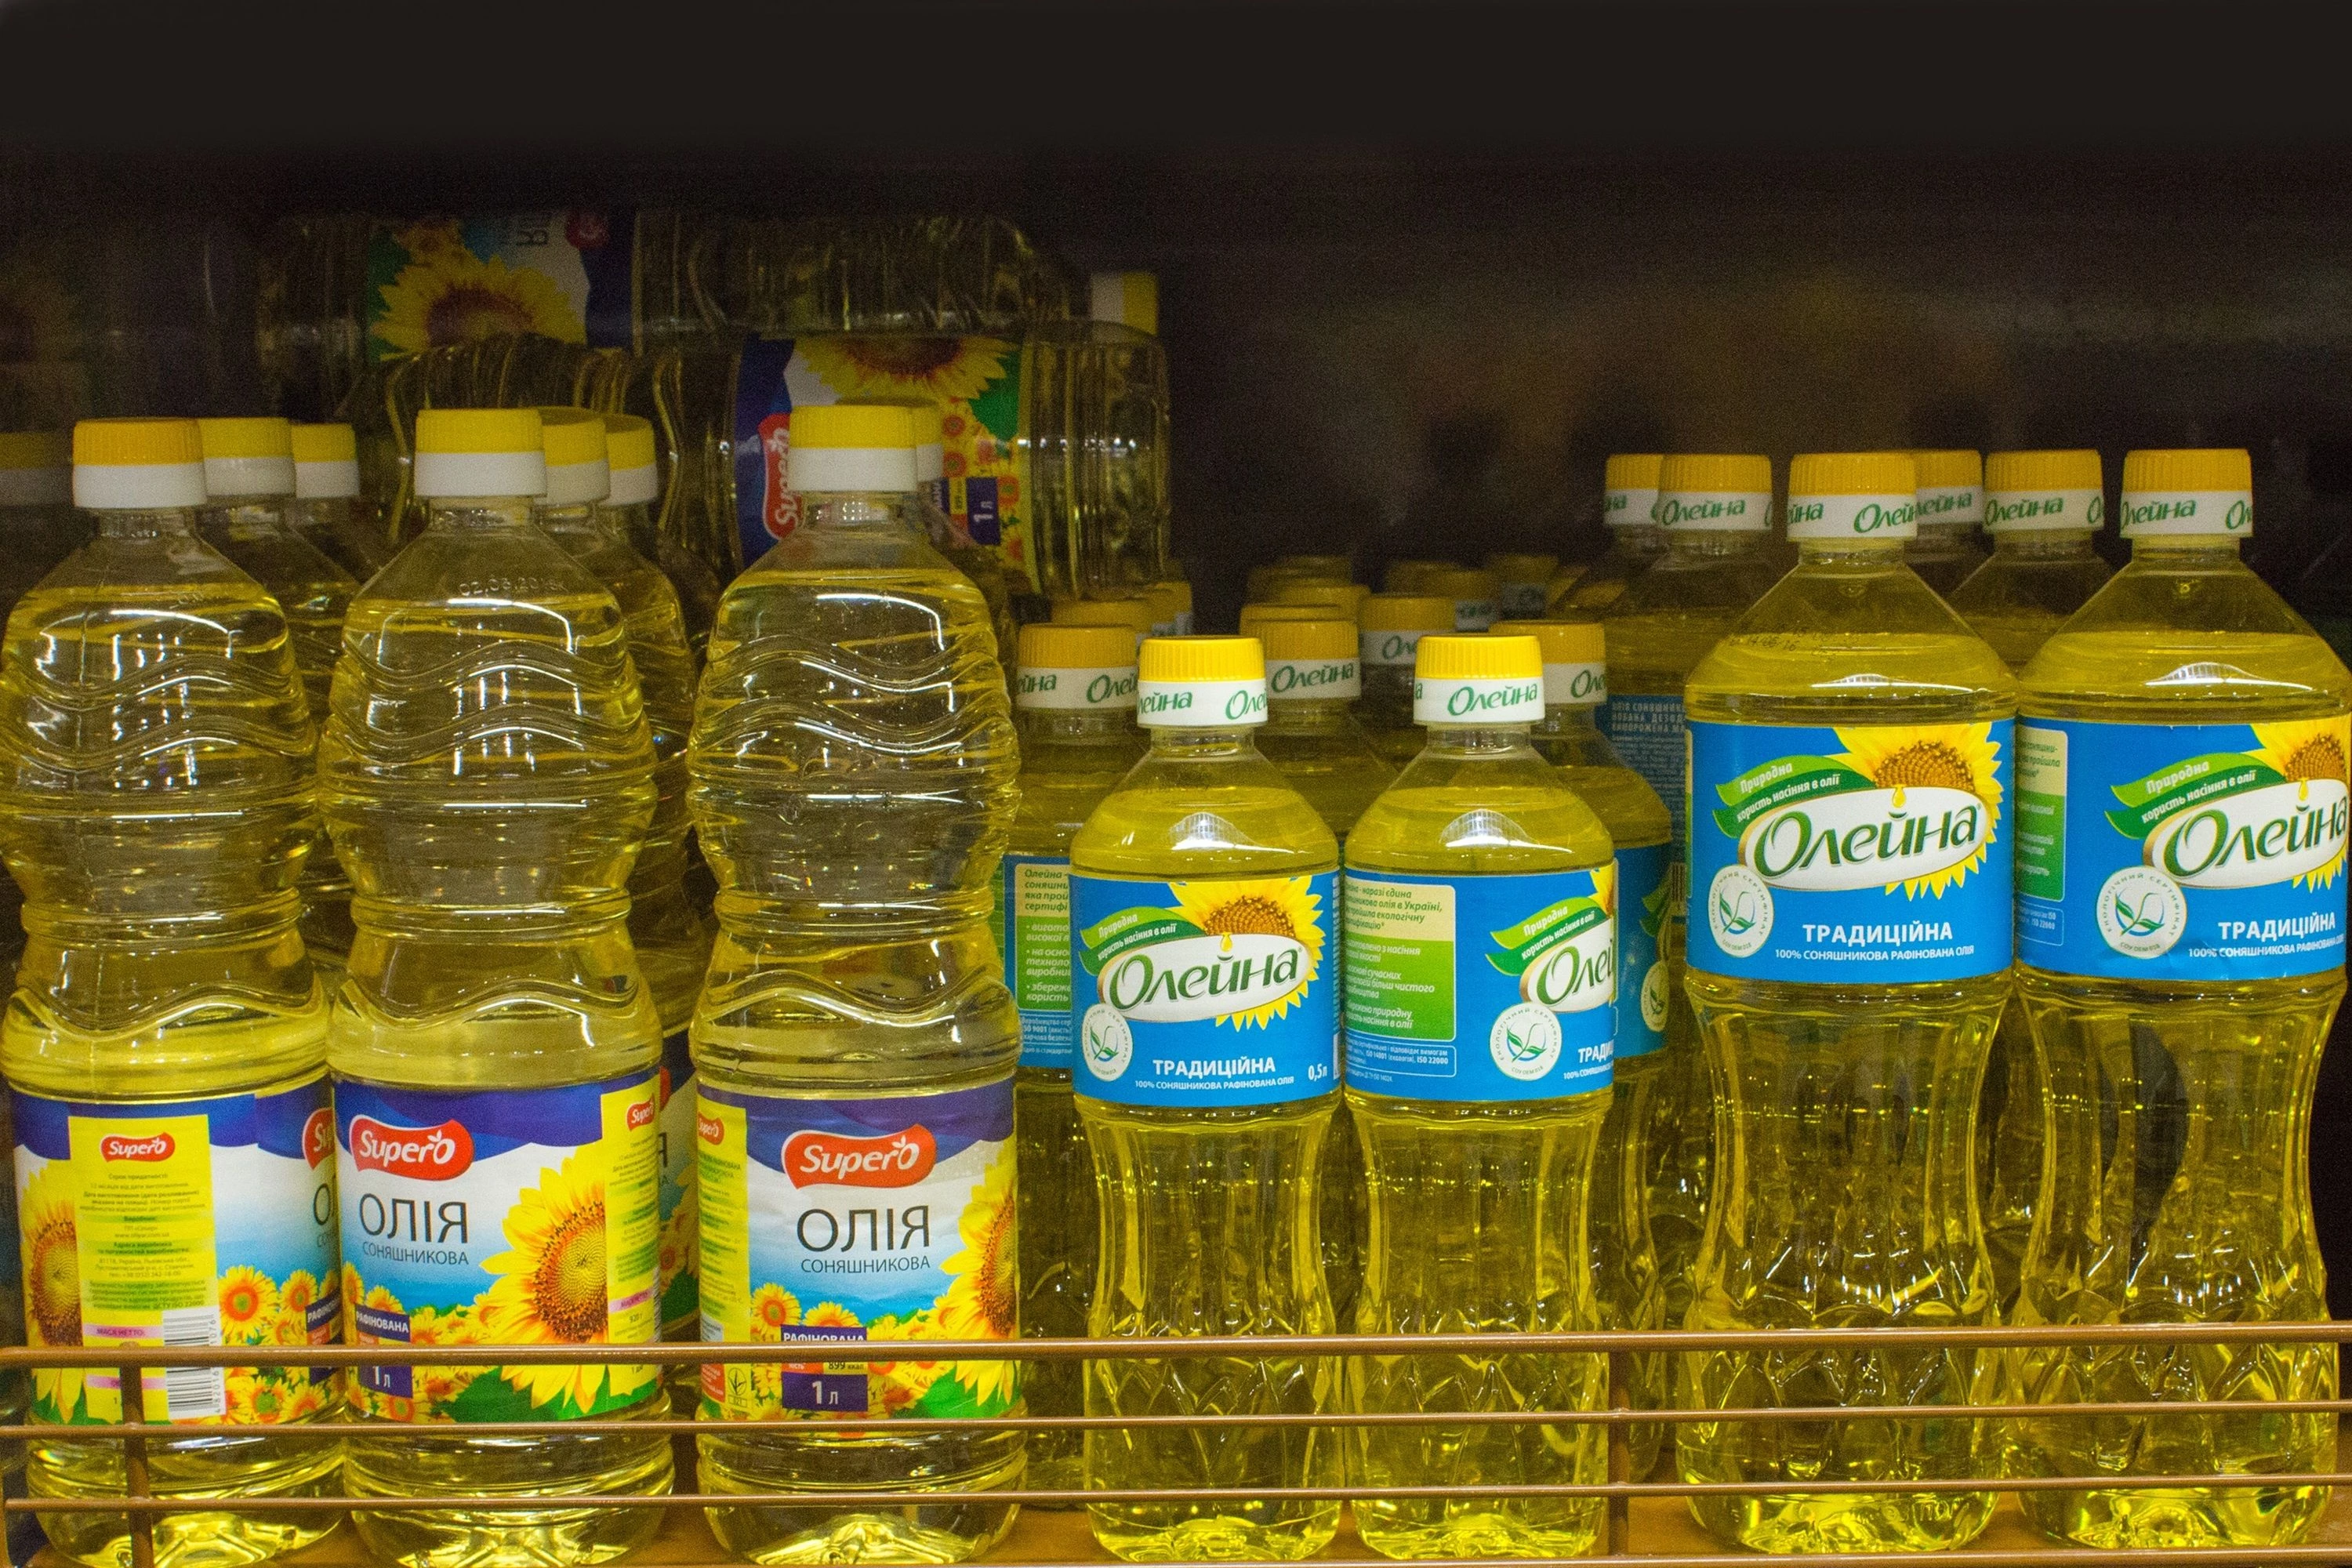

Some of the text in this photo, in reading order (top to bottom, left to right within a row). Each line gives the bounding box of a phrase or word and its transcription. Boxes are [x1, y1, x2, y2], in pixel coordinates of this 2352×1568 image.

[1663, 499, 1746, 526] Олейна
[1984, 497, 2063, 526] Олейна
[1270, 662, 1354, 694] Олейна
[1447, 683, 1537, 717] Олейна
[1740, 763, 1793, 794] Природна
[2146, 761, 2209, 794] Природна
[1737, 773, 1841, 822] користь насіння в олії
[2141, 769, 2256, 824] користь насіння в олії
[1754, 804, 1977, 878] Олейна
[2164, 797, 2348, 877] Олейна
[1025, 869, 1062, 878] Олейна
[1385, 887, 1412, 898] єдина
[1377, 911, 1425, 924] екологічну
[1379, 899, 1396, 908] олія
[1404, 901, 1443, 913] Україні,
[1098, 914, 1138, 938] Природна
[1523, 906, 1568, 936] Природна
[2218, 912, 2336, 942] ТРАДИЦІЙНА
[1124, 929, 1153, 946] насіння
[1160, 923, 1177, 935] олії
[1802, 920, 1954, 948] ТРАДИЦІЙНА
[1387, 944, 1421, 956] насіння
[1521, 935, 1554, 960] користь
[1775, 945, 1974, 961] 100% СОНЯШНИКОВА РАФІНОВАНА ОЛІЯ
[2188, 948, 2217, 957] 100%
[2219, 944, 2295, 957] СОНЯШНИКОВА
[1109, 948, 1298, 1010] Олейна
[1395, 984, 1435, 993] чистого
[1026, 993, 1069, 1003] користь
[1373, 1007, 1412, 1019] природну
[1396, 1019, 1414, 1029] олії
[1153, 1056, 1276, 1080] ТРАДИЦІЙНА
[1156, 1080, 1221, 1090] СОНЯШНИКОВА
[1223, 1078, 1276, 1089] РАФІНОВАНА
[1277, 1076, 1294, 1085] ОЛІЯ
[108, 1137, 166, 1158] Supero
[359, 1129, 456, 1167] Supero
[800, 1136, 920, 1179] Supero
[359, 1192, 469, 1244] ОЛІЯ
[797, 1205, 931, 1253] ОЛІЯ
[362, 1241, 470, 1266] СОНЯШНИКОВА
[801, 1255, 931, 1274] СОНЯШНИКОВА
[372, 1366, 390, 1388] 1 л
[812, 1381, 839, 1405] 1 л
